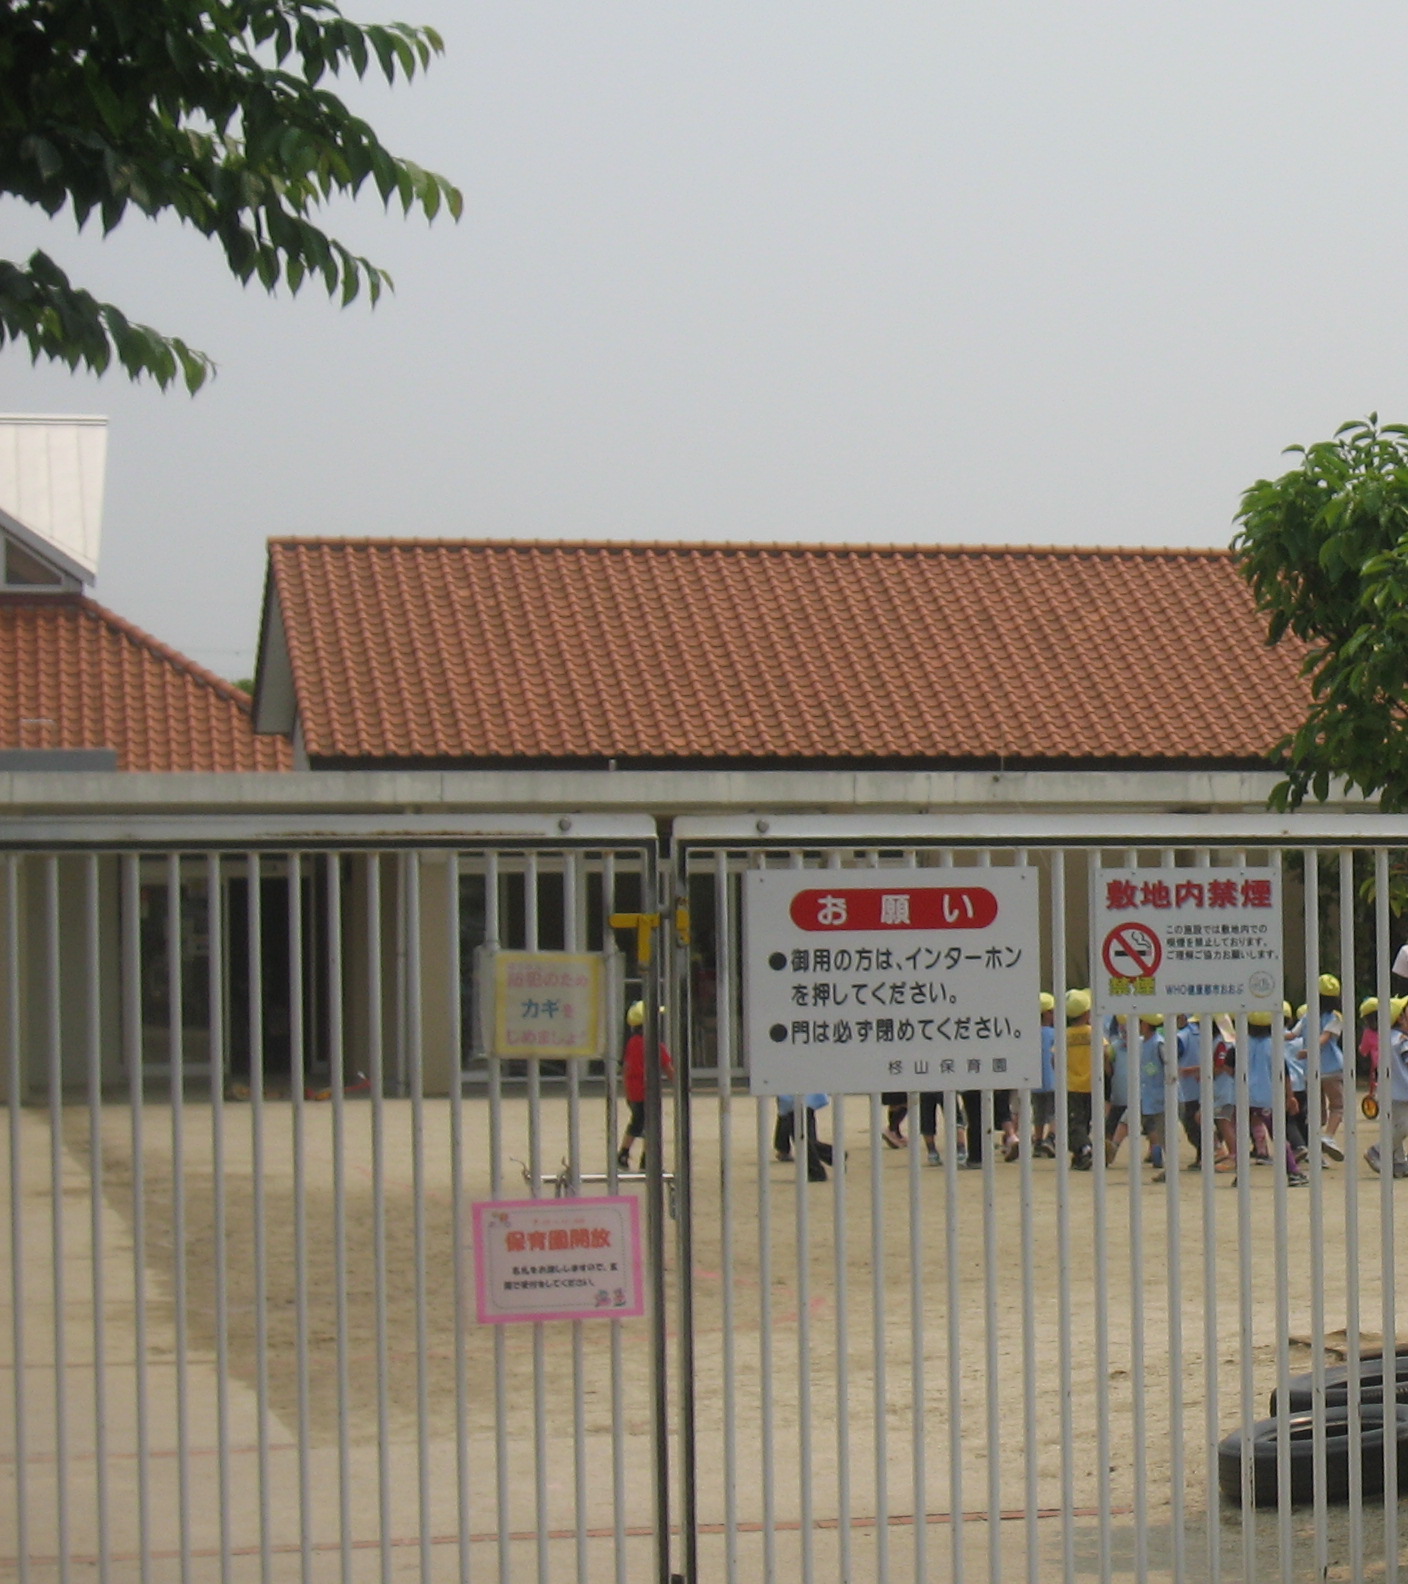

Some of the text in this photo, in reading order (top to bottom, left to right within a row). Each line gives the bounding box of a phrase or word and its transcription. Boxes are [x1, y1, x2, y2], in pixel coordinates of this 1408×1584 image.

[1106, 879, 1273, 910] 敷地内禁煙
[816, 894, 974, 925] お願い
[791, 947, 1022, 973] 御用の方は、インターホン
[791, 982, 957, 1007] を押してください。
[791, 1017, 1022, 1045] 門は必ず閉めてください。
[888, 1058, 1008, 1075] 柊山保育園
